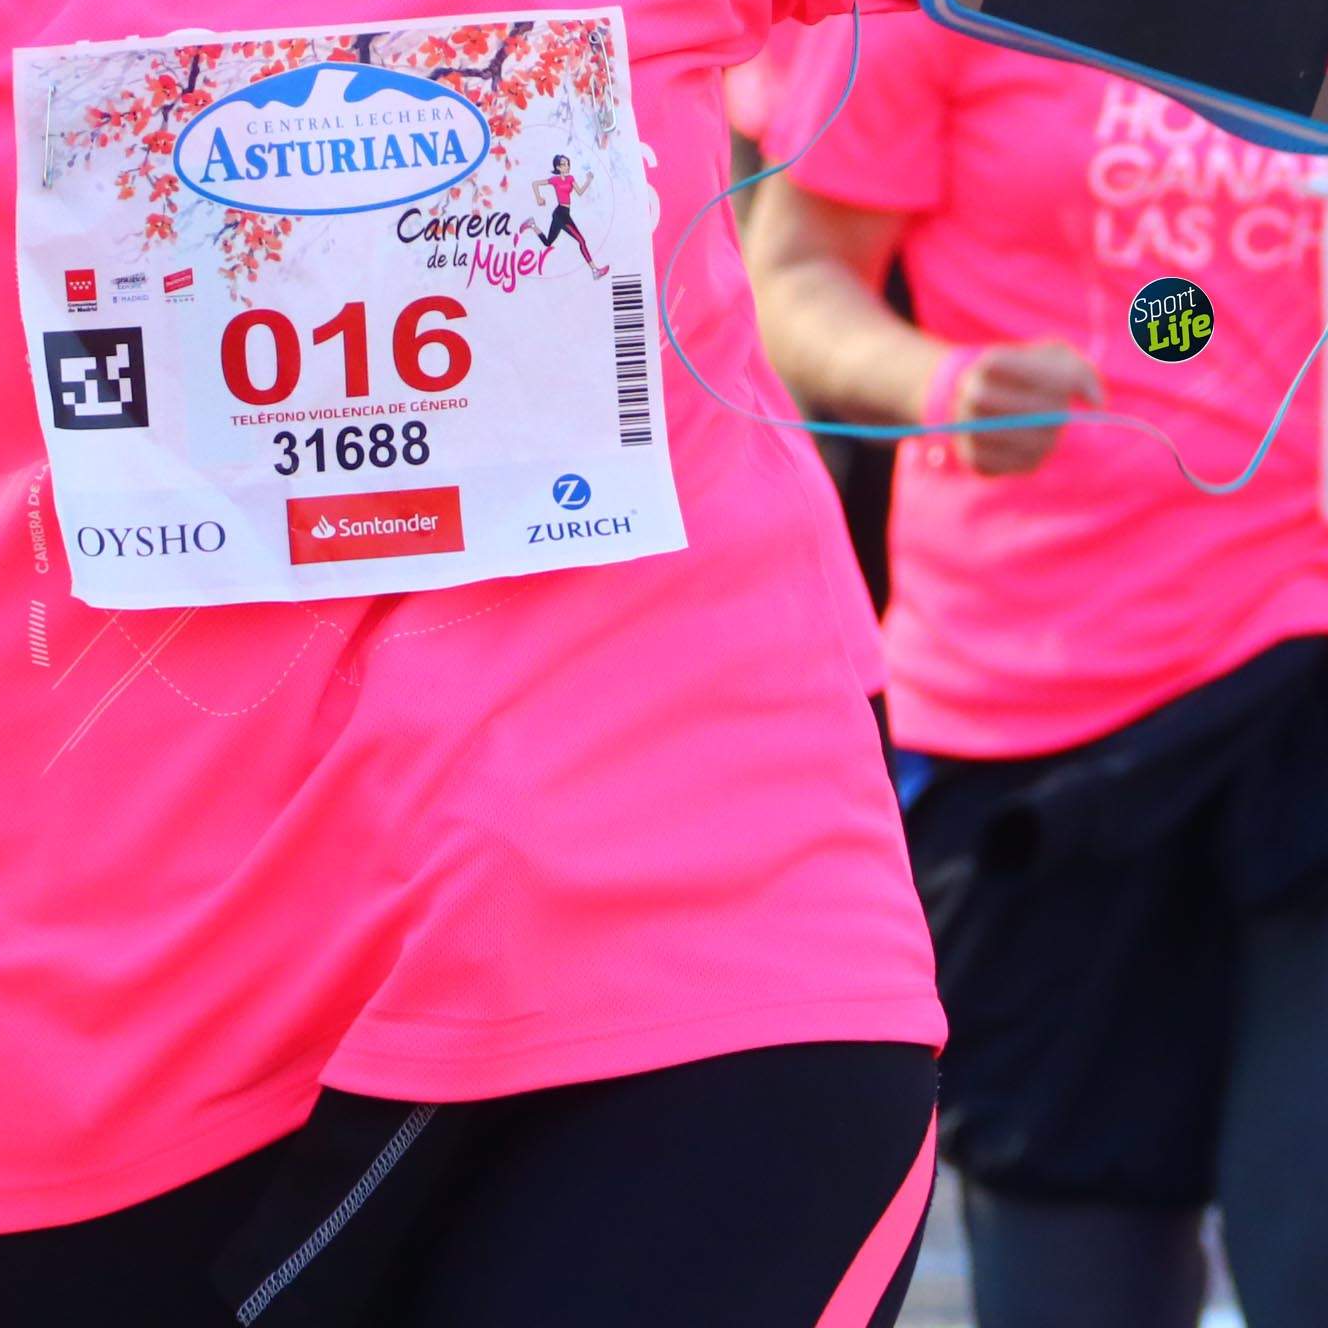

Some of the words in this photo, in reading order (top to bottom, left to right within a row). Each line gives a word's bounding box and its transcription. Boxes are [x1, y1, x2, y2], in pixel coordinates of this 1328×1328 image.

[247, 116, 345, 135] CENTRAL
[355, 107, 455, 127] LECHERA
[199, 127, 468, 183] ASTURIANA
[396, 208, 512, 243] Carrera
[1095, 205, 1215, 269] LAS
[427, 246, 448, 269] de
[453, 243, 468, 267] la
[466, 232, 555, 293] Mujer
[220, 295, 472, 406] 016
[231, 412, 306, 426] TELÉFONO
[309, 404, 385, 420] VIOLENCIA
[389, 402, 407, 413] DE
[410, 397, 469, 412] GÉNERO
[273, 420, 430, 476] 31688
[29, 509, 50, 574] CARRERA
[77, 520, 226, 557] OYSHO
[339, 514, 438, 537] Santander
[527, 517, 631, 544] ZURICH
